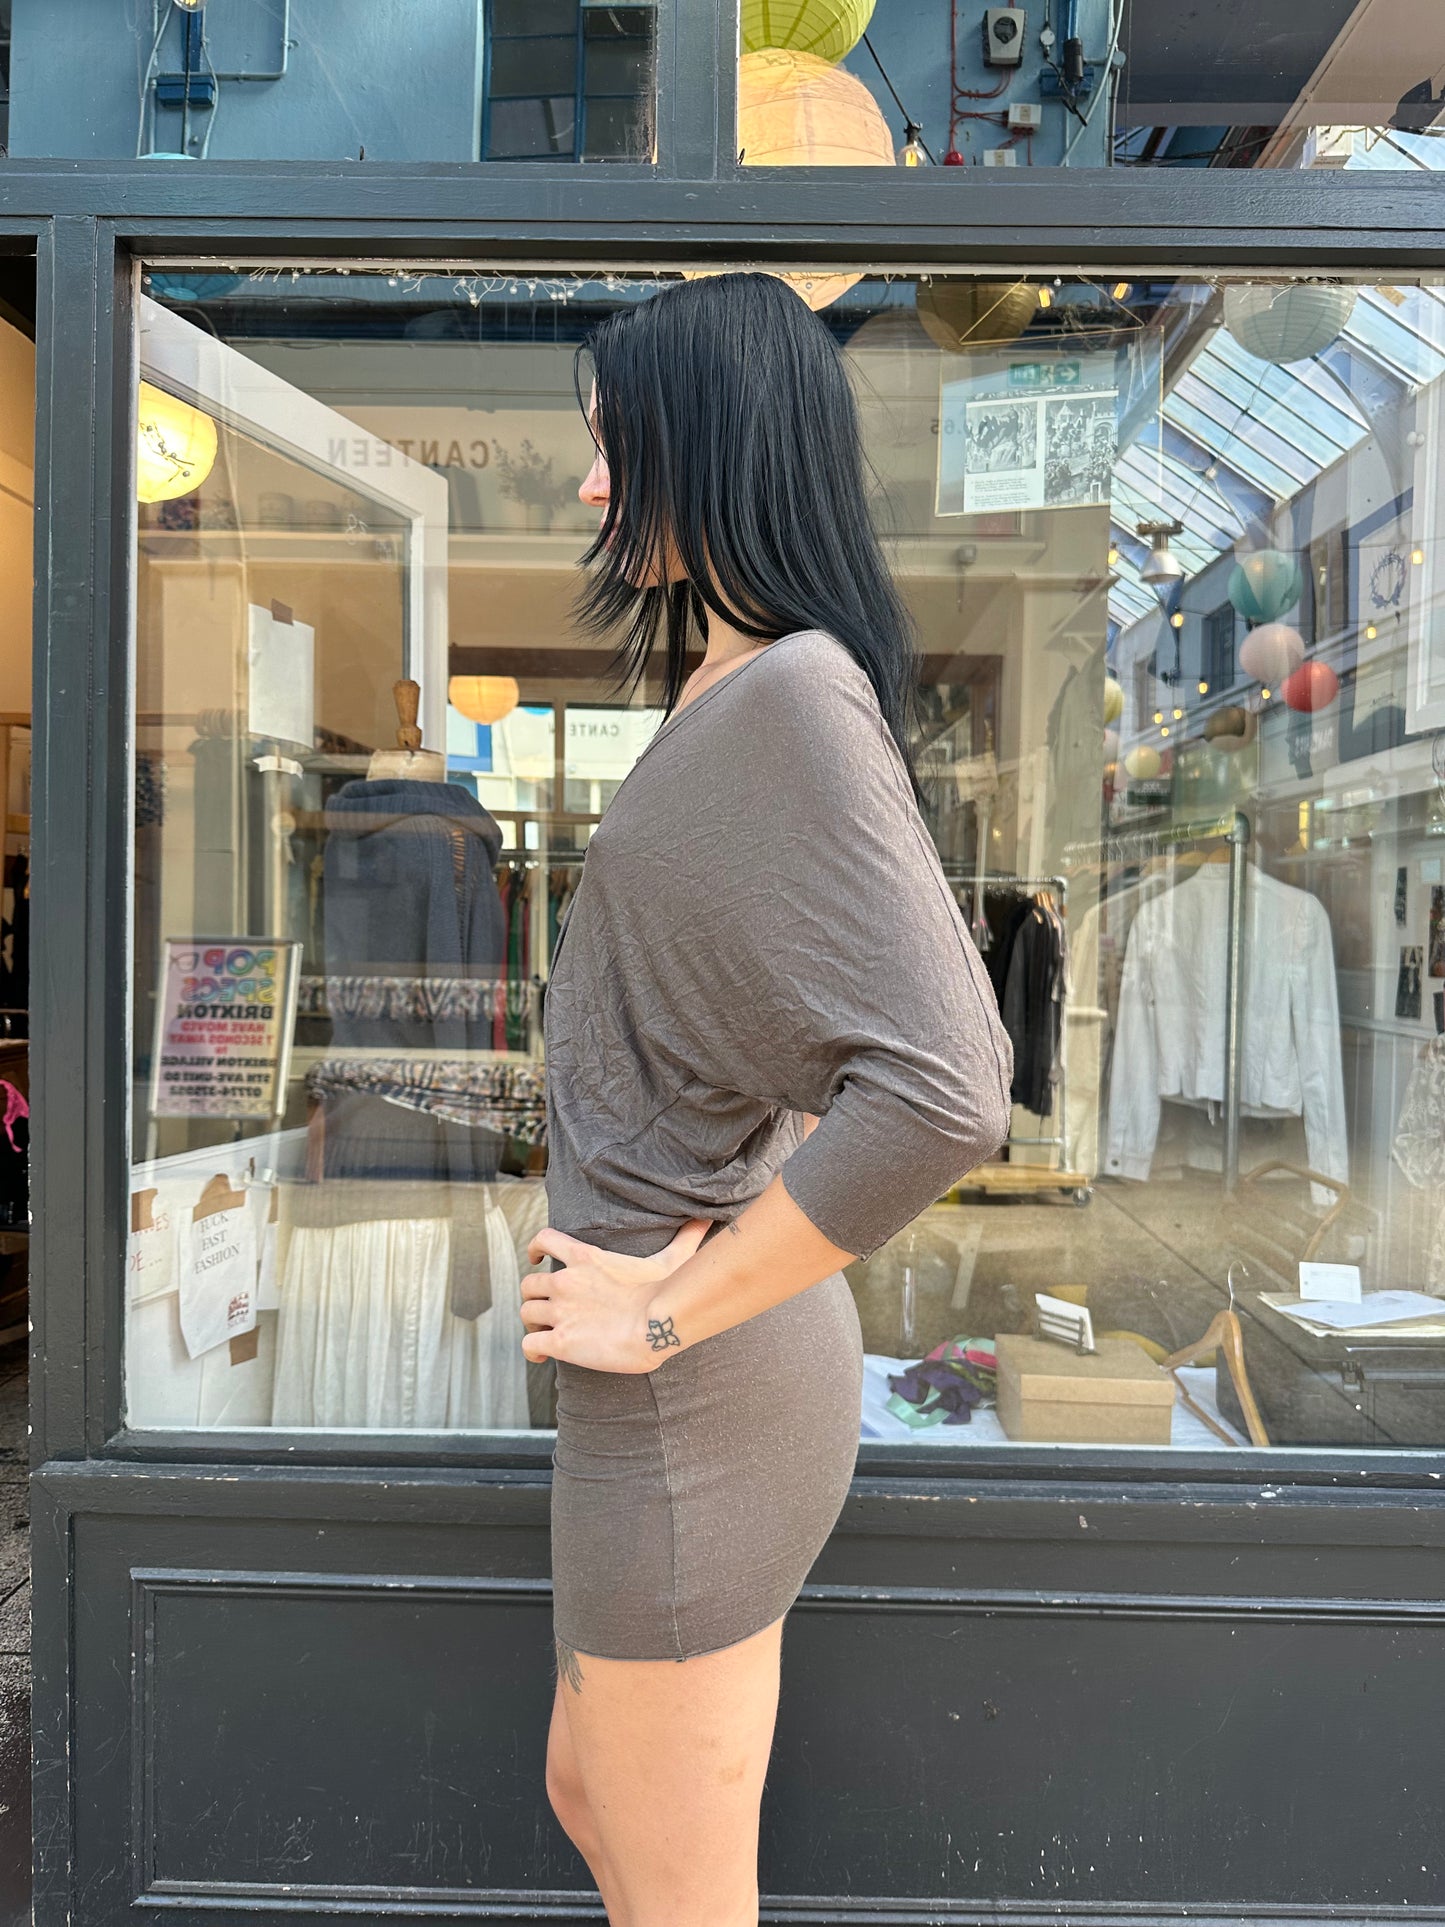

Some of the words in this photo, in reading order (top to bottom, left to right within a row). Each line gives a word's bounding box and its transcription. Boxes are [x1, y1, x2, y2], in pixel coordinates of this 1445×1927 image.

[200, 1211, 229, 1233] FUCK
[202, 1230, 227, 1251] FAST
[194, 1243, 241, 1274] FASHION
